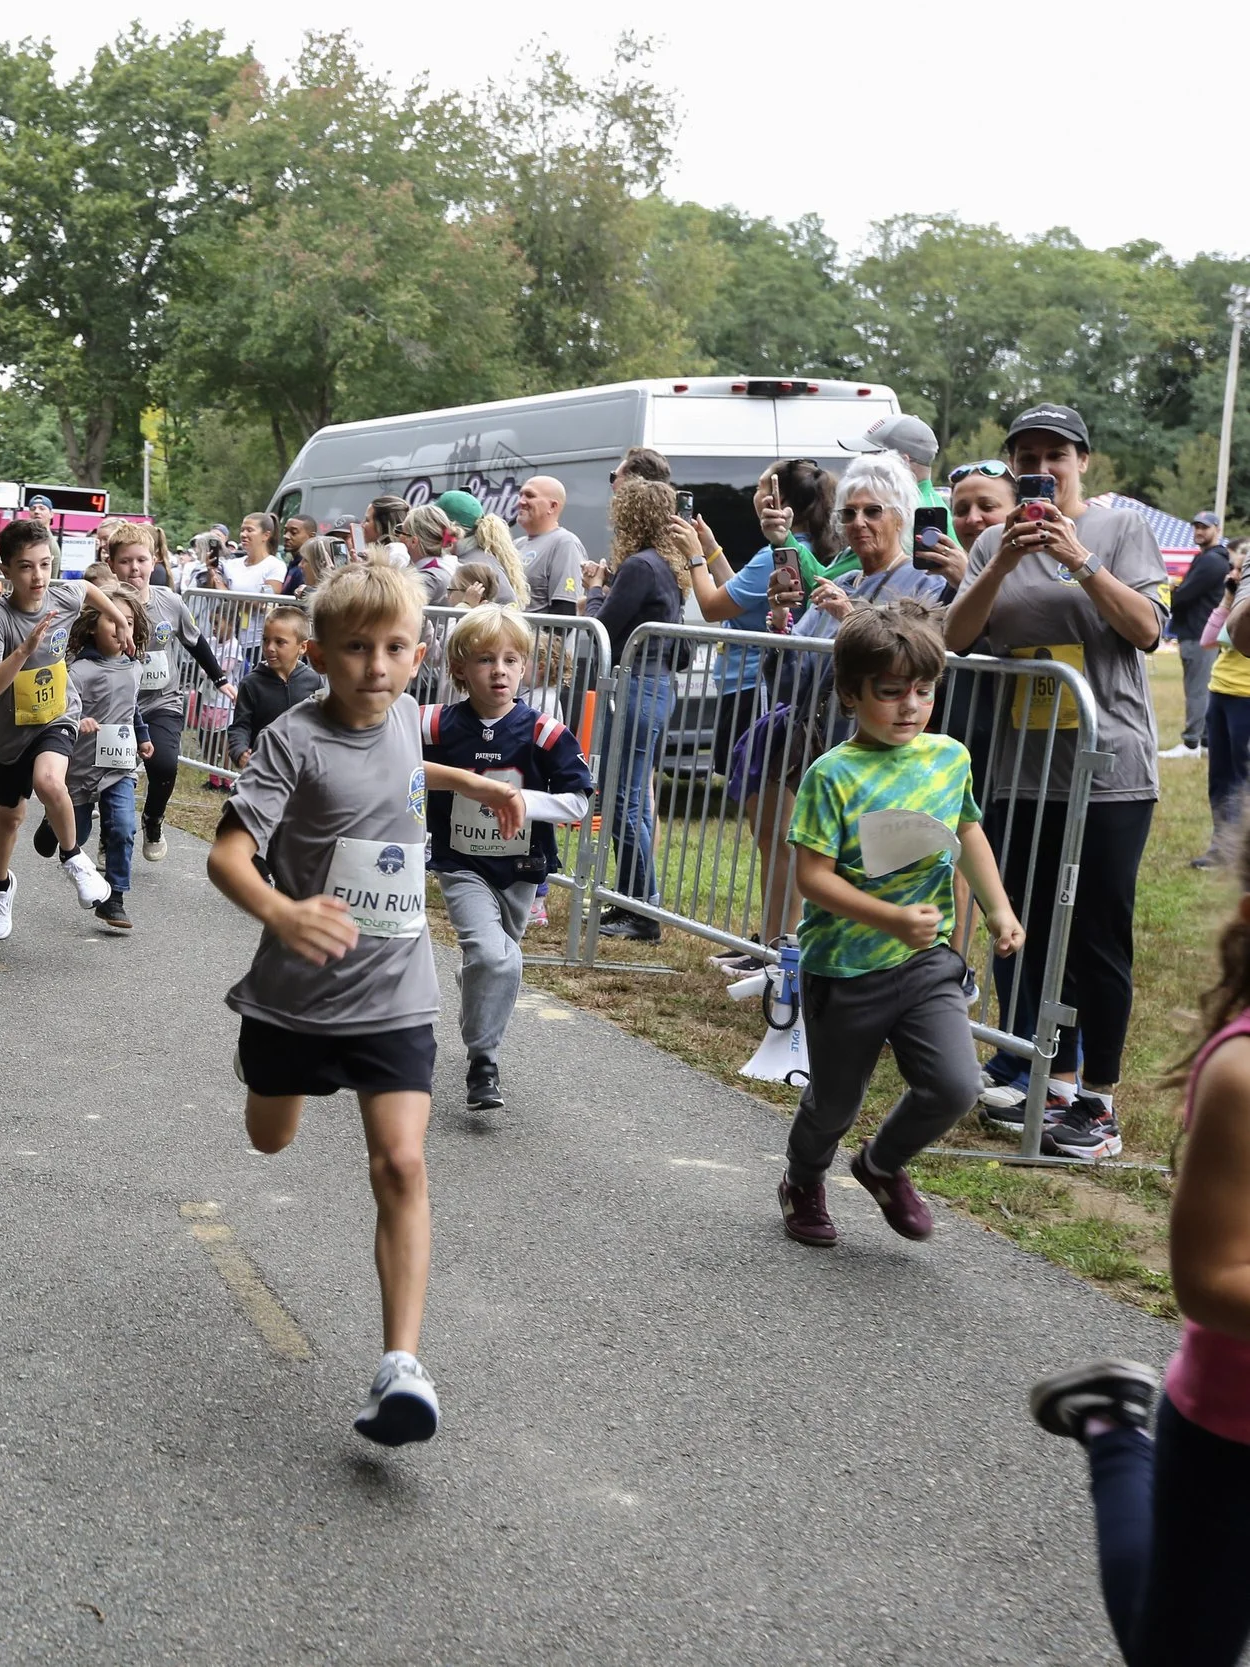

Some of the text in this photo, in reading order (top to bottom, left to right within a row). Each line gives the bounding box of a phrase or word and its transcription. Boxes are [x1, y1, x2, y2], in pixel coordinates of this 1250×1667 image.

[91, 495, 105, 512] 4
[146, 671, 167, 680] RUN
[35, 686, 55, 703] 151
[1033, 675, 1055, 697] 150
[100, 747, 136, 757] FUN RU
[475, 752, 502, 763] PATRIOTS
[454, 823, 526, 841] FUN RN
[333, 886, 422, 912] FUN RUN
[363, 919, 401, 930] DUFFY
[791, 1029, 800, 1053] PYLE
